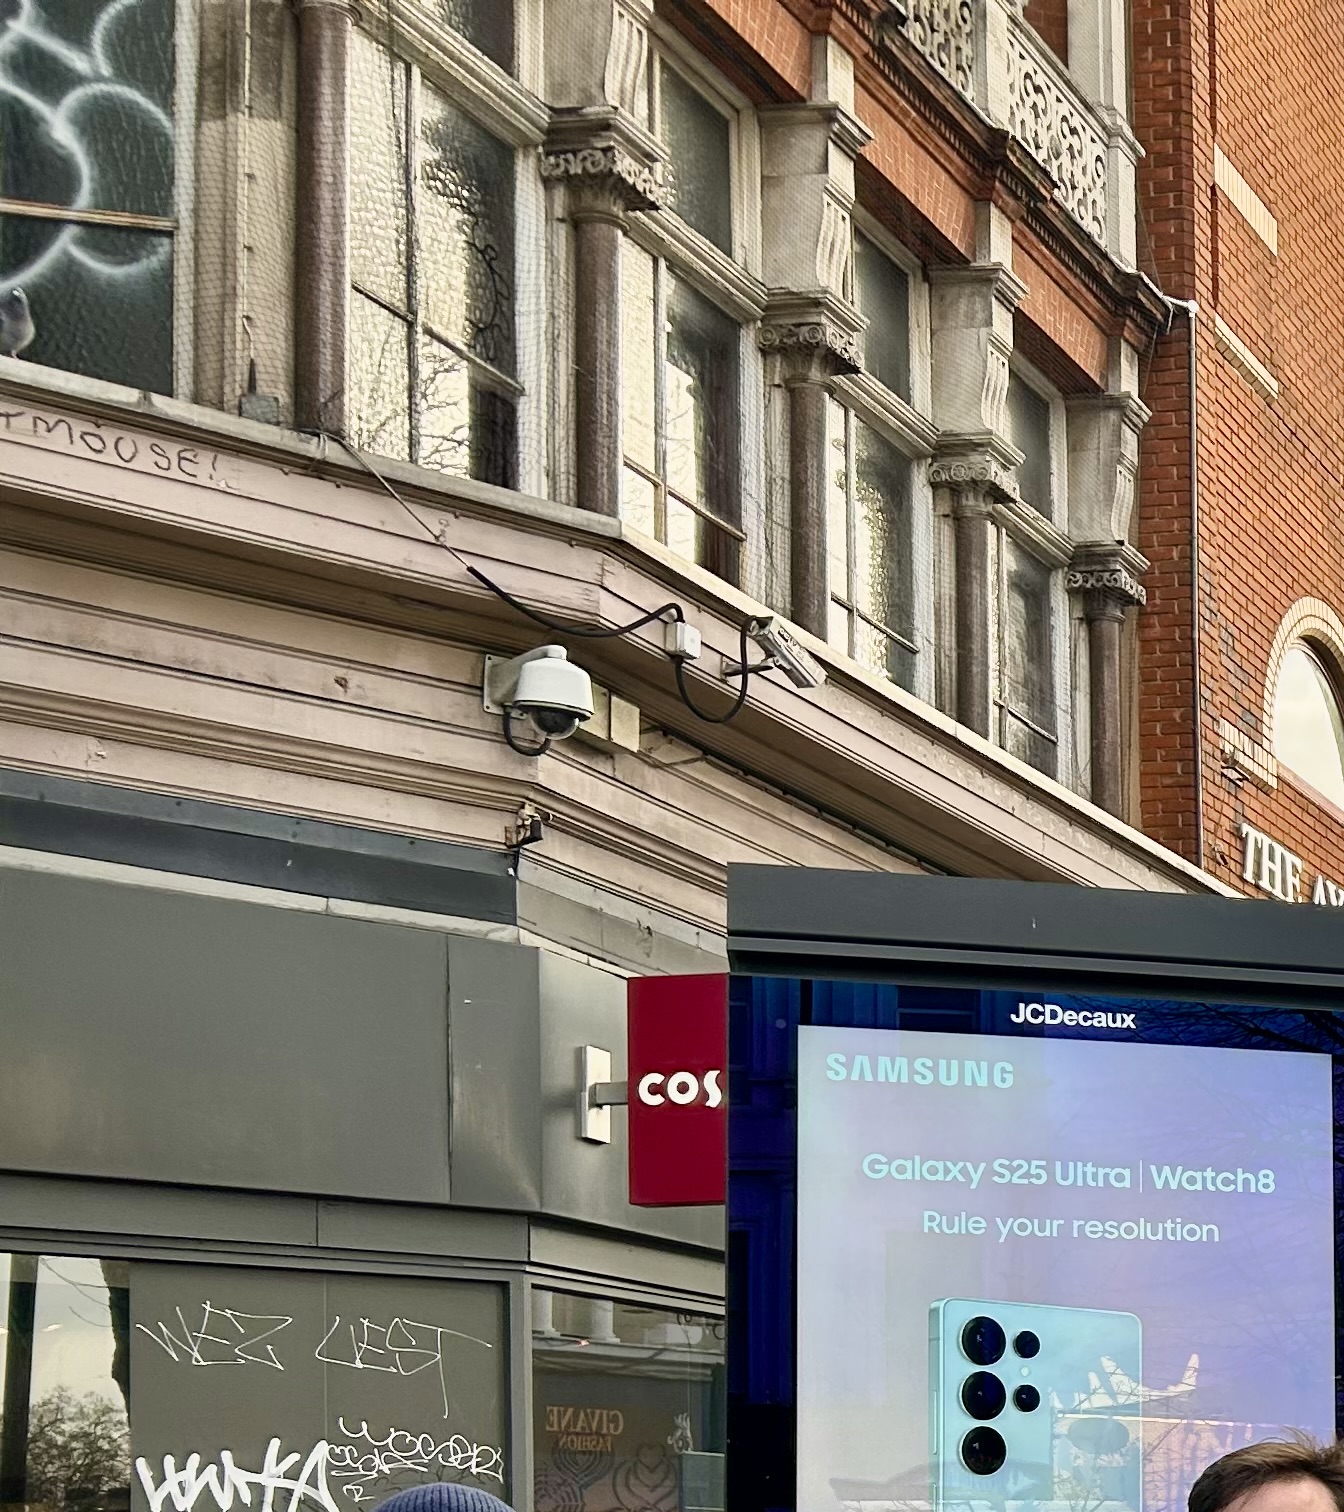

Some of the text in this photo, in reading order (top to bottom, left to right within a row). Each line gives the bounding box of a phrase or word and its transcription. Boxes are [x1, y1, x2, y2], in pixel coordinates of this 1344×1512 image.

[1240, 822, 1303, 903] THE
[1010, 1002, 1137, 1030] JCDecaux
[826, 1052, 1014, 1090] SAMSUNG
[862, 1152, 1276, 1195] Galaxy S25 Ultra Watch8
[923, 1211, 1220, 1243] Rule your resolution
